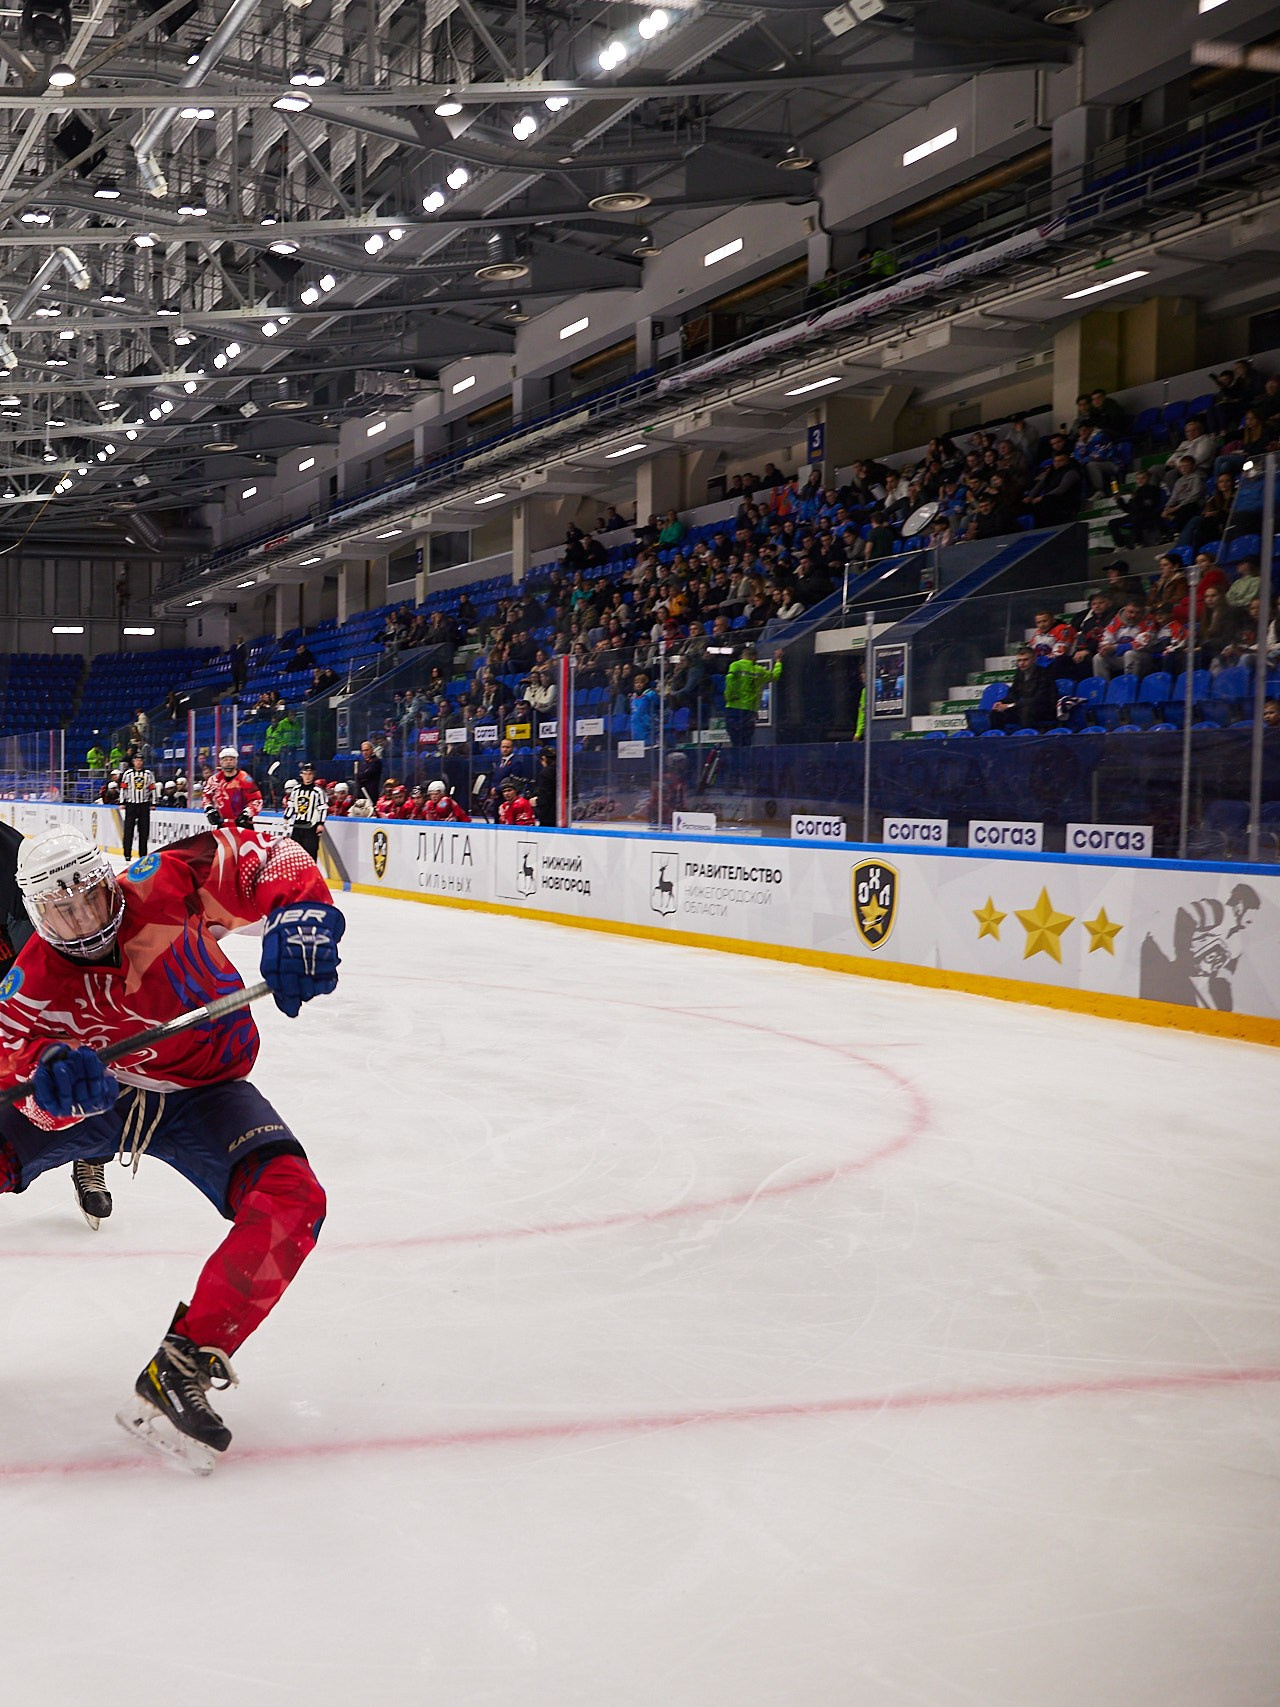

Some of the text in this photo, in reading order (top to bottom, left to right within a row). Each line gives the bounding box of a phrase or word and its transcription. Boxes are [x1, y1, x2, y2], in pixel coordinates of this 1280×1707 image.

[812, 429, 821, 448] 3
[416, 832, 473, 866] ЛИГА
[542, 855, 582, 873] НИЖНИЙ
[684, 862, 783, 884] ПРАВИТЕЛЬСТВО
[418, 872, 472, 893] СИЛЬНЫХ
[542, 875, 591, 897] НОВГОРОД
[684, 885, 773, 905] НИЖЕГОРОДСКОЙ
[683, 900, 728, 917] ОБЛАСТИ
[264, 909, 327, 936] UER
[228, 1124, 285, 1153] EASTON
